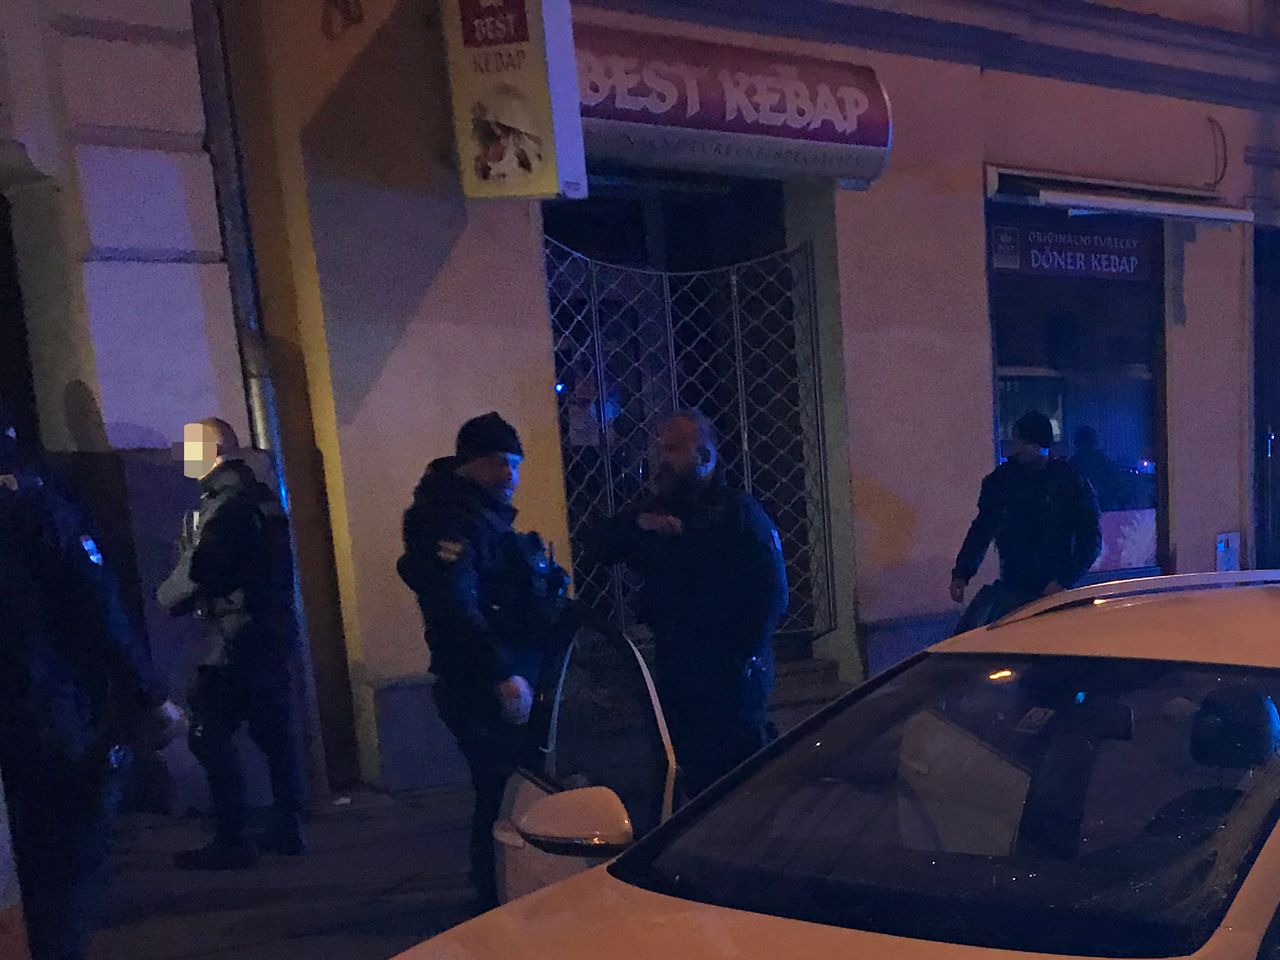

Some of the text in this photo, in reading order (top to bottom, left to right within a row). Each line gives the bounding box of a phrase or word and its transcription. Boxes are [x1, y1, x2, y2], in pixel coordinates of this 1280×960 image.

[473, 14, 516, 41] BEST
[473, 49, 526, 74] KEBAP
[577, 54, 869, 135] BEST KEBAP
[1091, 253, 1138, 273] KEBAP
